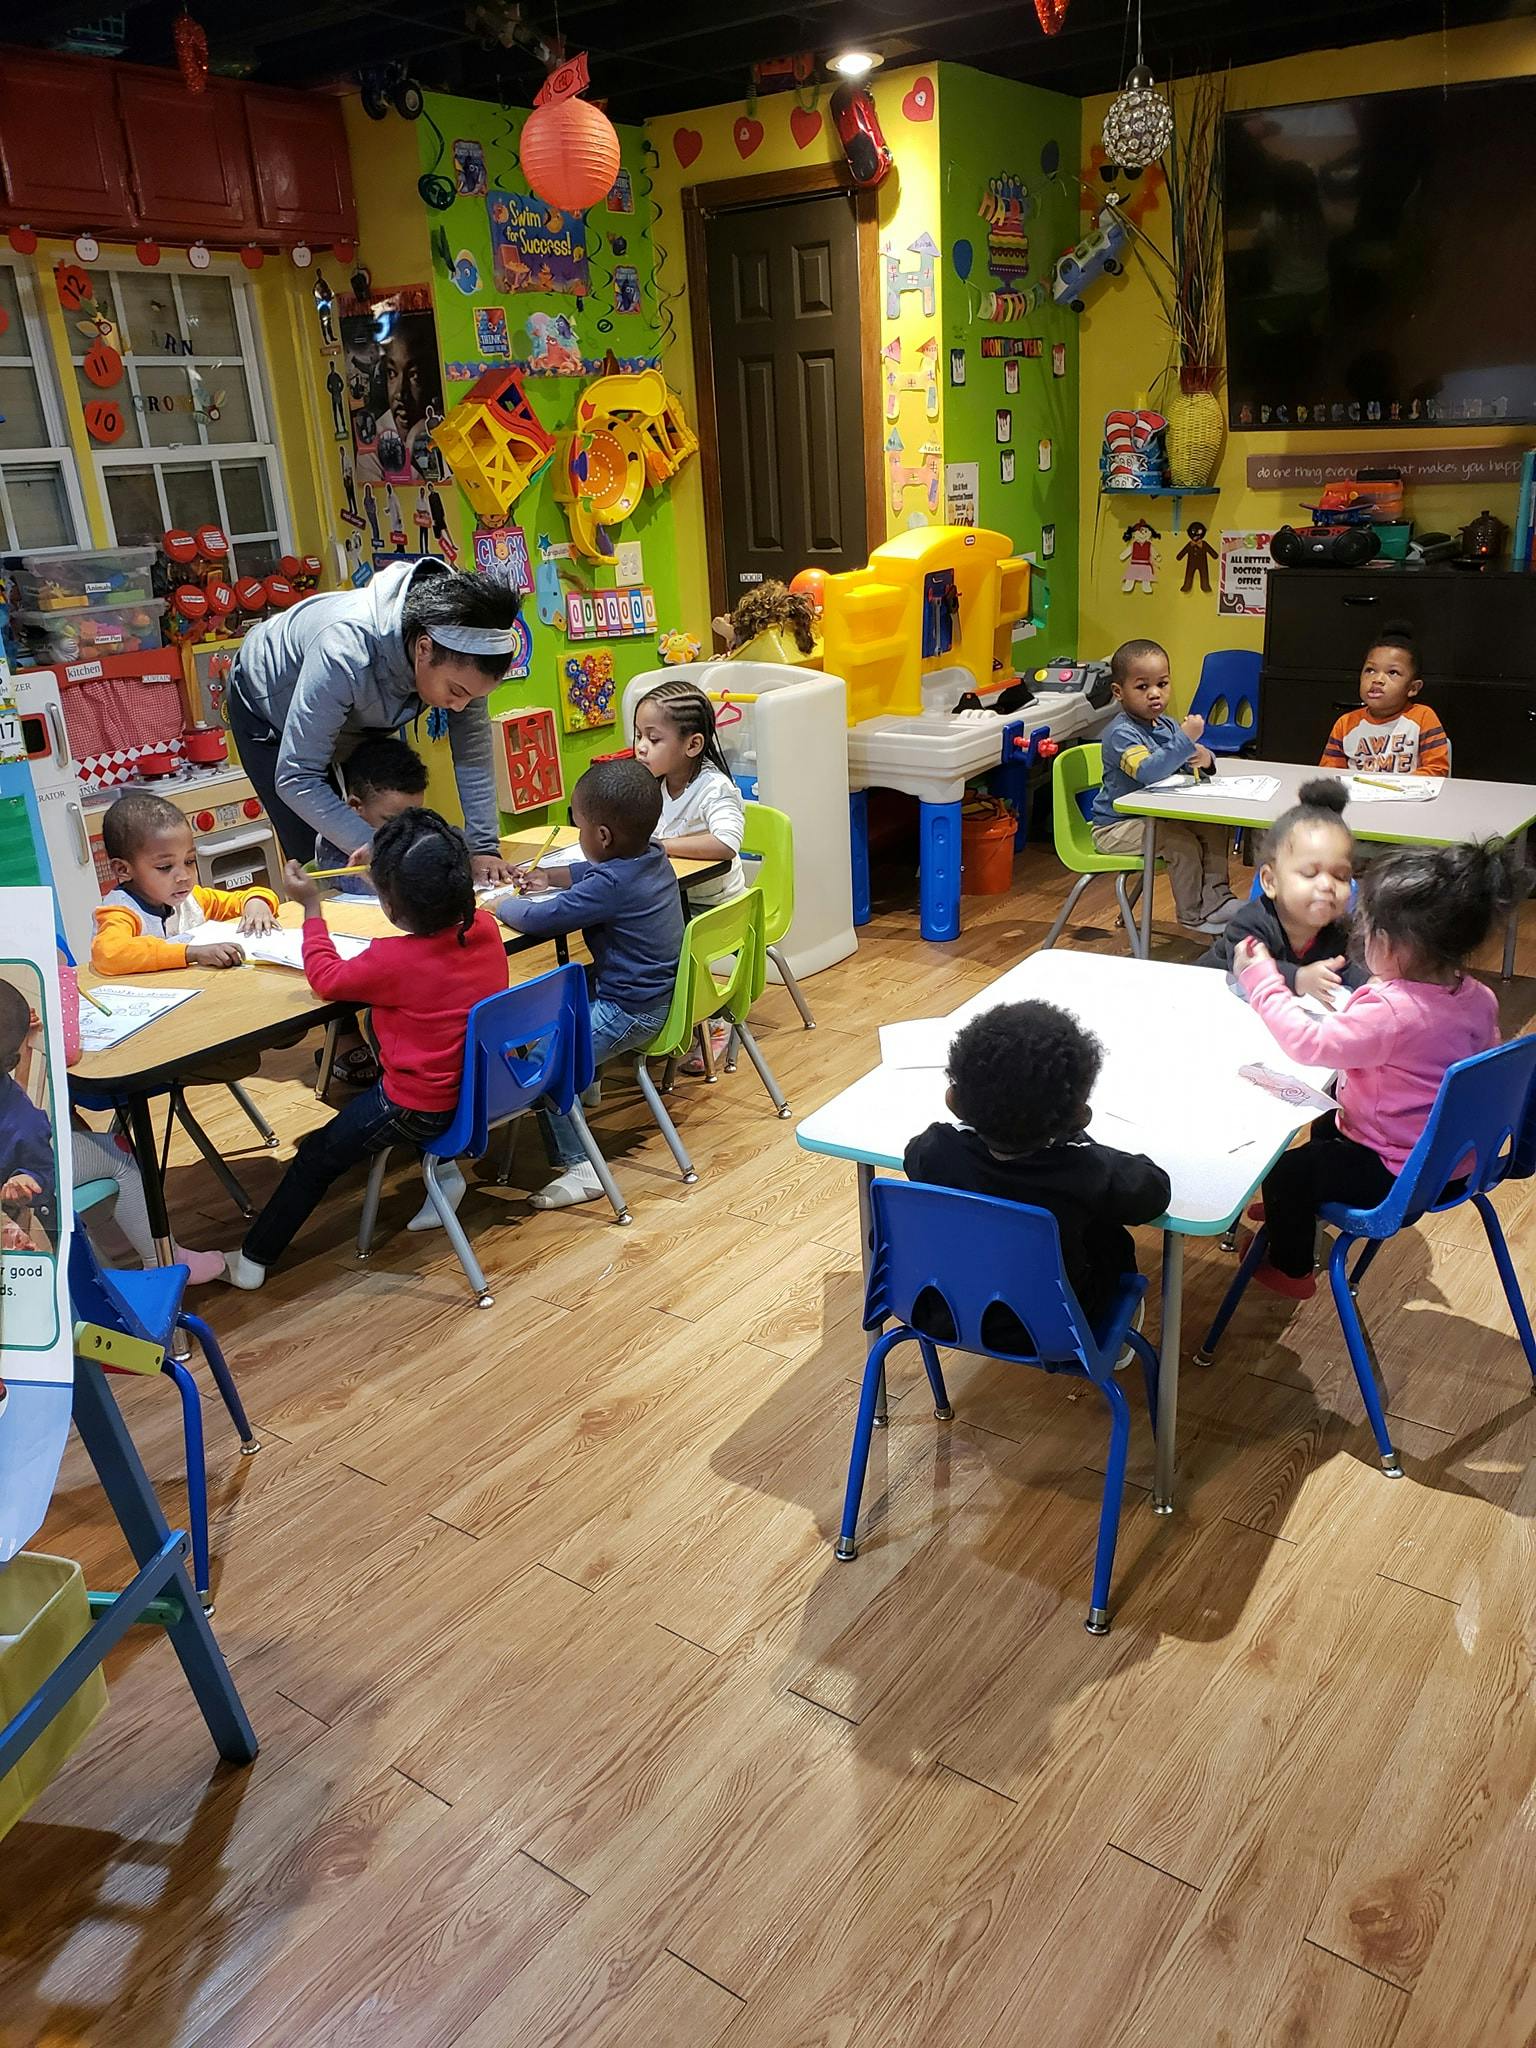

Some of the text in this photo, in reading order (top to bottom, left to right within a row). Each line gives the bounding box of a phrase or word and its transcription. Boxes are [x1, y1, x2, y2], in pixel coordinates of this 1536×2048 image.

[508, 199, 542, 229] Swim
[505, 227, 572, 256] for Success!
[63, 274, 86, 301] 12
[93, 355, 108, 377] 11
[94, 408, 116, 433] 10
[1257, 466, 1271, 478] do
[1273, 468, 1291, 479] one
[1294, 466, 1322, 484] thing
[1325, 466, 1358, 479] every
[1418, 462, 1457, 475] makes
[1461, 462, 1485, 480] you
[1231, 556, 1271, 564] ALL BETTER
[1233, 566, 1268, 575] DOCTOR'S
[86, 583, 111, 592] Animals
[1237, 577, 1262, 586] OFFICE
[67, 665, 100, 679] kitchen
[1355, 734, 1414, 756] AWE-
[226, 873, 252, 889] OVEN
[10, 1265, 42, 1279] good
